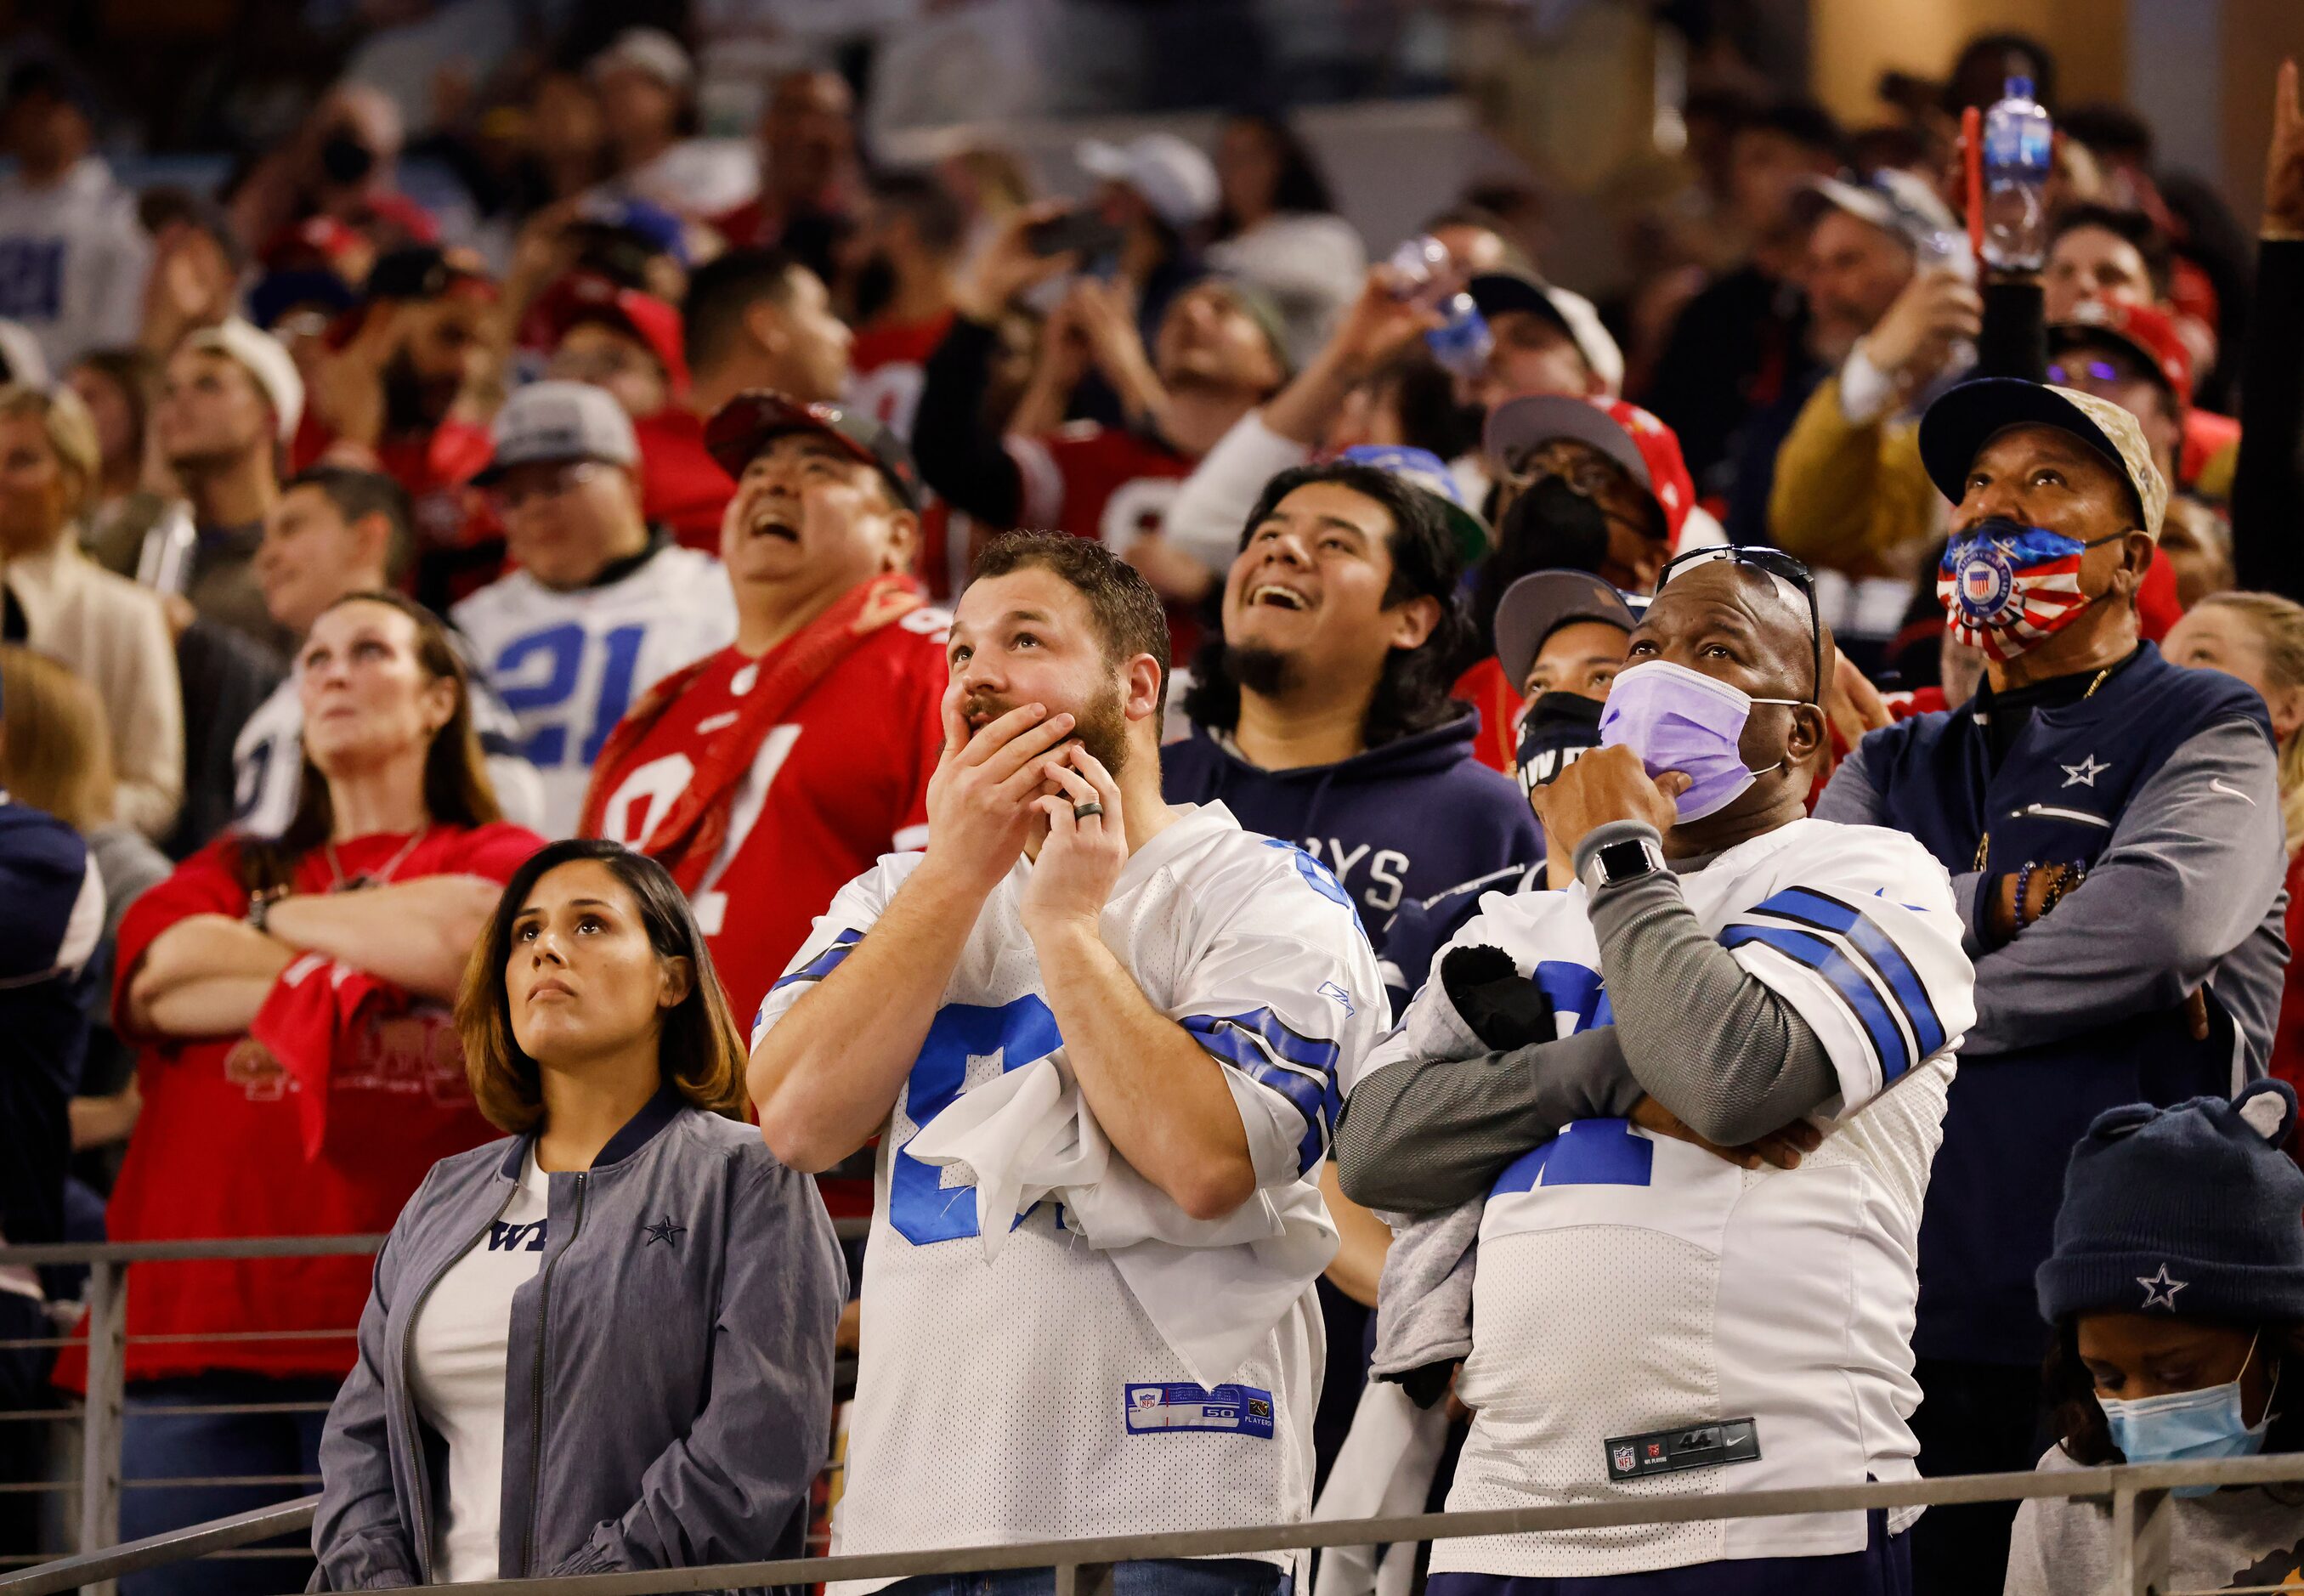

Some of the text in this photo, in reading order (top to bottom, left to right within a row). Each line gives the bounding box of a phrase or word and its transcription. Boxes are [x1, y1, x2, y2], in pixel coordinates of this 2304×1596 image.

[496, 620, 644, 769] 21
[1207, 1409, 1235, 1418] 50
[1618, 1455, 1633, 1469] NFL
